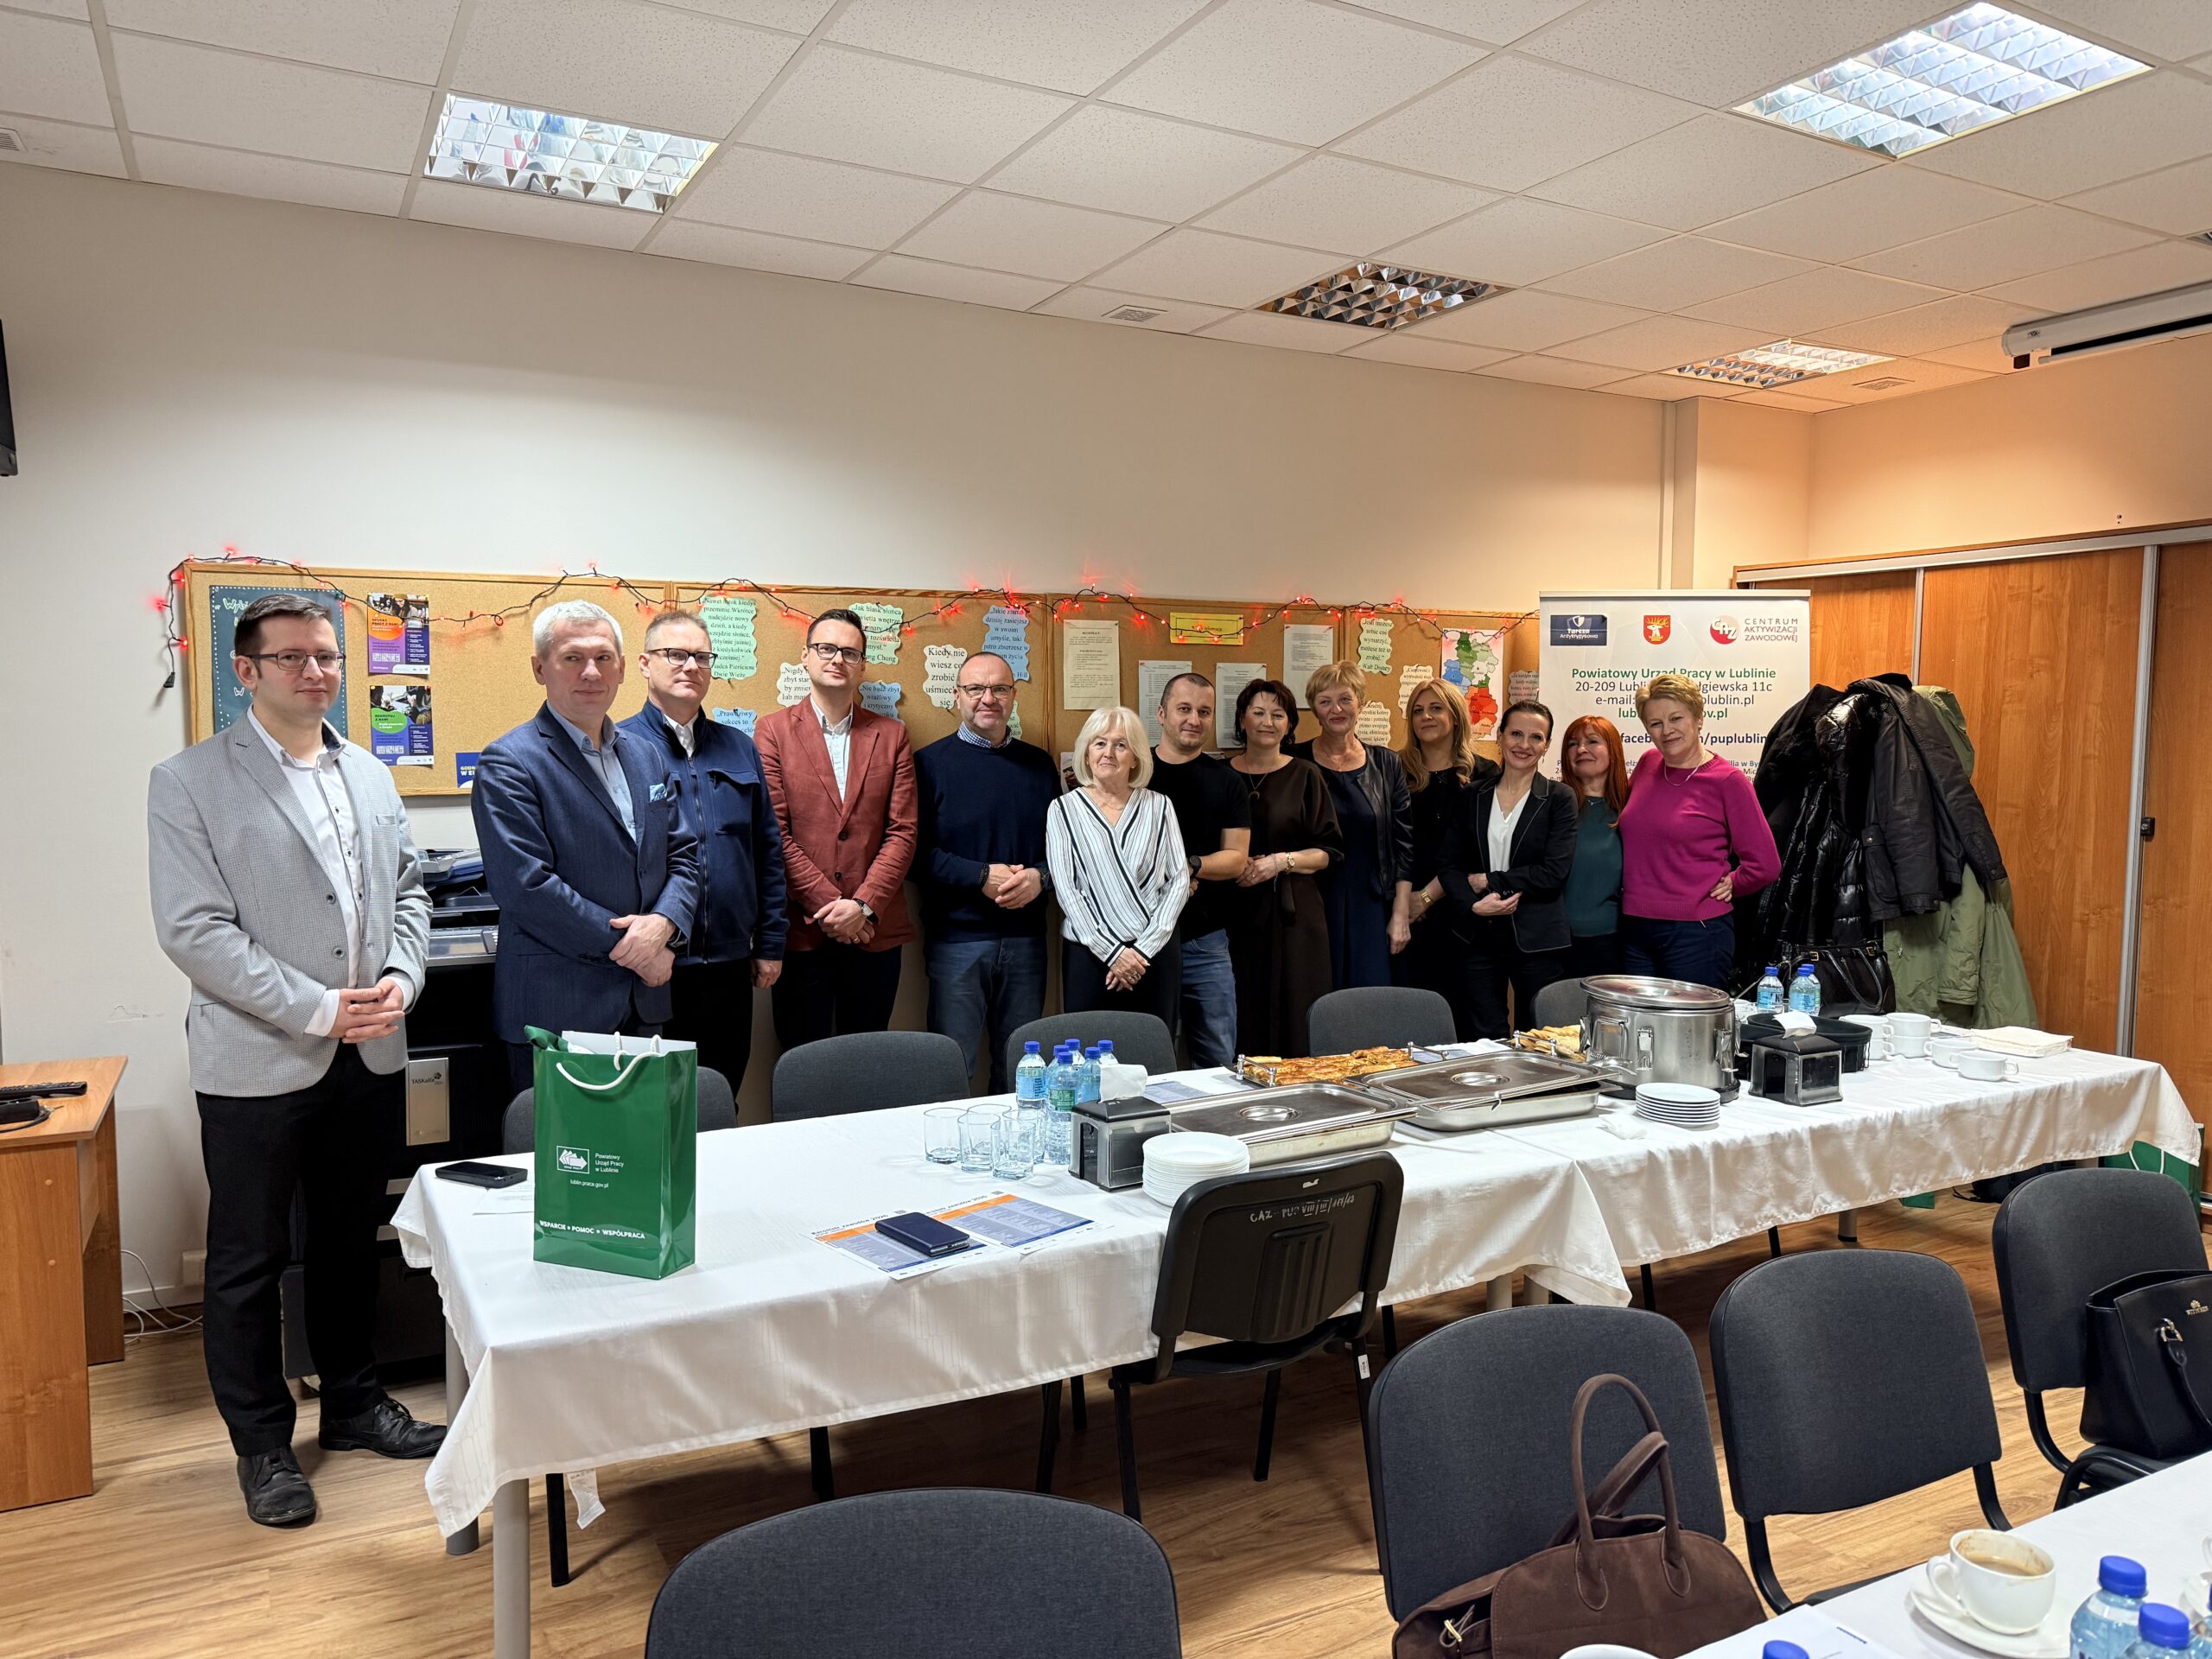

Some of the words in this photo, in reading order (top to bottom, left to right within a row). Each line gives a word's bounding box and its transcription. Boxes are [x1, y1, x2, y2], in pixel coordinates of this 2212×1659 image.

[928, 648, 950, 658] Kiedy
[931, 660, 951, 669] wiesz
[1572, 668, 1637, 680] Powiatowy
[1680, 668, 1712, 680] Pracy
[1729, 668, 1777, 678] Lublinie
[1575, 681, 1616, 691] 20-209
[1619, 681, 1649, 691] Lubli
[1699, 681, 1748, 694] łgiewska
[1752, 682, 1772, 691] 11c
[1595, 695, 1636, 705] e-mail:
[1618, 708, 1637, 718] lub
[1702, 708, 1728, 720] ov.pl
[1621, 733, 1652, 743] faceb
[570, 1179, 608, 1188] lublin.praca.gov.pl
[1250, 1211, 1272, 1223] CAZ
[539, 1220, 566, 1230] WSPARCIE
